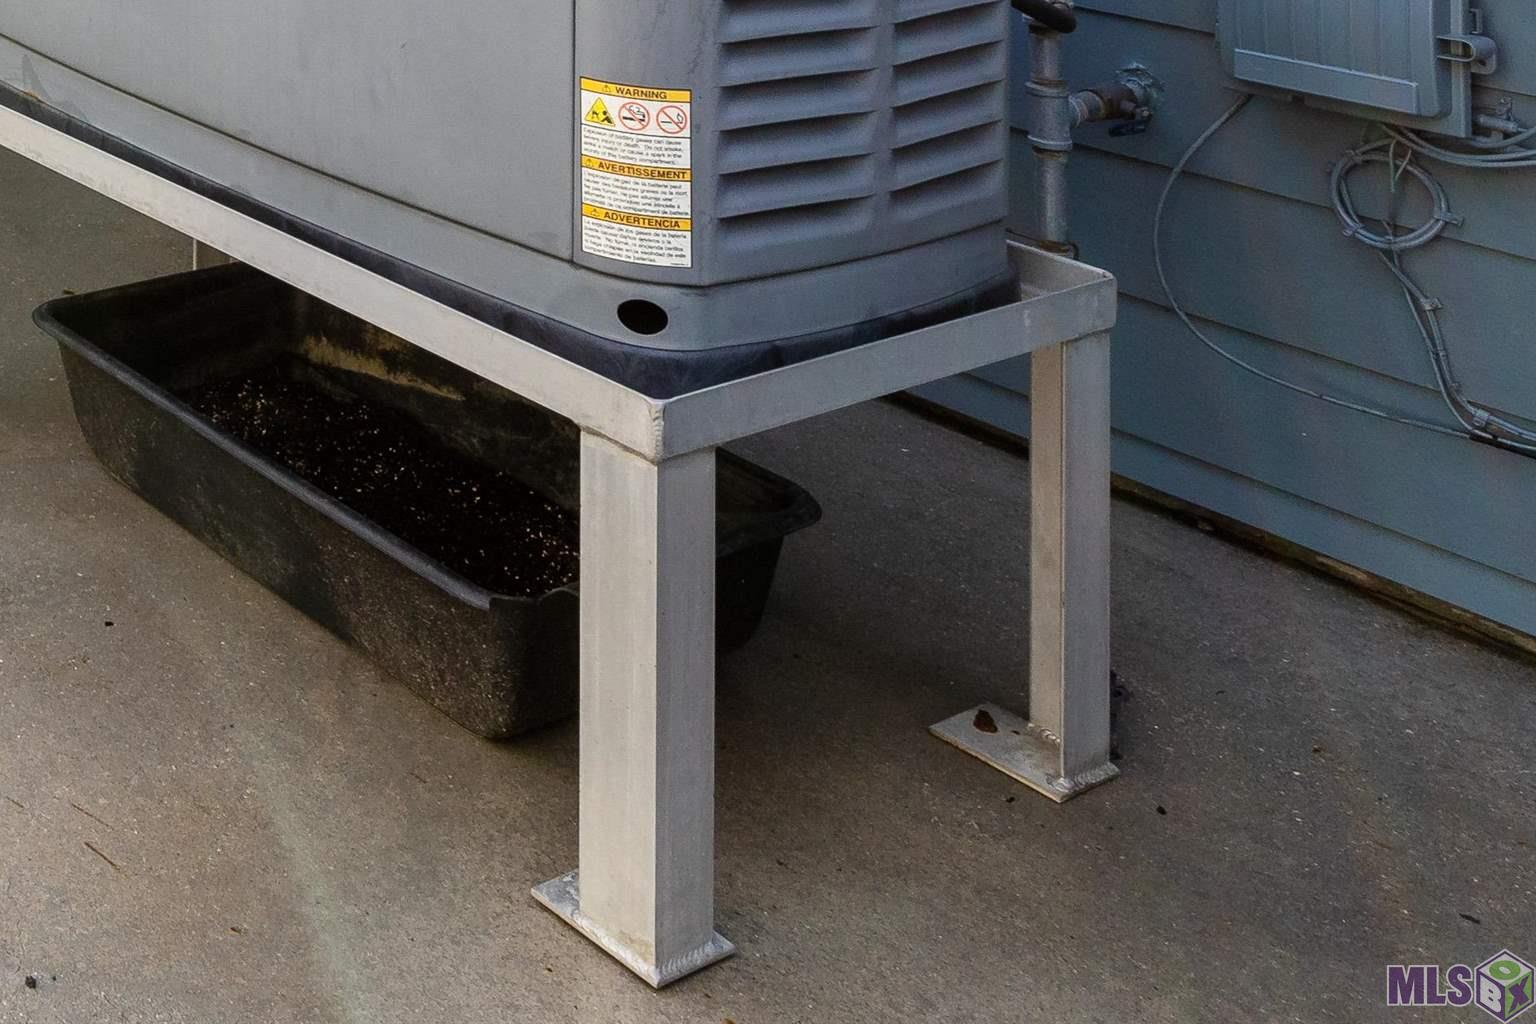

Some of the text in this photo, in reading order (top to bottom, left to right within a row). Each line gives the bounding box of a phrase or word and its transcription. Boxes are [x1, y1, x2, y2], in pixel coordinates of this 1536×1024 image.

[615, 86, 667, 100] WARNING
[598, 161, 687, 179] AVERTISSEMENT
[603, 211, 681, 229] ADVERTENCIA
